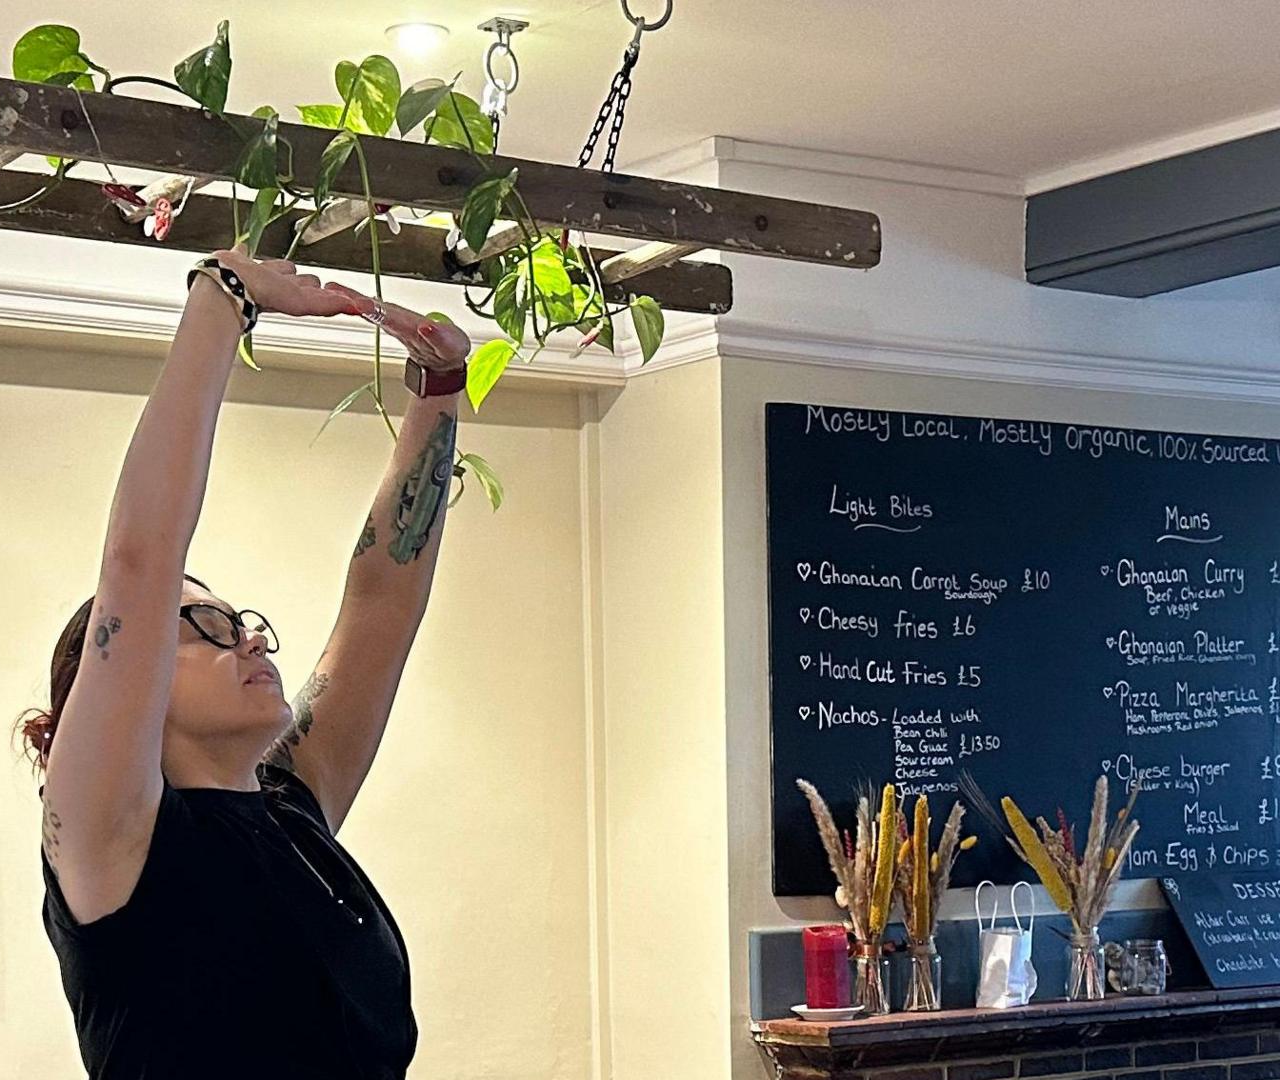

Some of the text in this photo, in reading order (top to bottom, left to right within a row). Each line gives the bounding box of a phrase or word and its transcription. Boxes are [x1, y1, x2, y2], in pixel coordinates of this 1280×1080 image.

[805, 405, 890, 441] Mostly
[979, 418, 1052, 455] Mostly
[1158, 433, 1197, 460] 100%
[1202, 438, 1269, 464] Sourced
[829, 483, 933, 522] Light Bites
[1165, 505, 1210, 531] Mains
[911, 566, 960, 592] Carrot
[969, 572, 1007, 593] Soup
[1020, 568, 1050, 593] £10
[1117, 558, 1189, 587] Ghanaian
[1204, 558, 1245, 594] Curry
[944, 590, 997, 605] Sourdough
[1180, 584, 1225, 601] Chicken
[818, 606, 879, 638] Cheesy
[952, 614, 976, 637] £6
[1149, 604, 1161, 616] or
[1193, 630, 1245, 655] Platter
[819, 651, 862, 681] Hand
[866, 660, 896, 684] Cut
[957, 665, 982, 688] £5
[1115, 680, 1160, 708] Pizza
[1176, 681, 1259, 712] Margherita
[891, 707, 942, 726] Loaded
[893, 725, 921, 739] Bean
[895, 740, 914, 753] Pea
[919, 739, 948, 753] Guac
[920, 755, 954, 766] cream
[1116, 754, 1171, 780] Cheese
[895, 767, 939, 780] Cheese
[1184, 801, 1229, 825] Meal
[1165, 841, 1198, 871] Egg
[1223, 842, 1270, 868] Chips
[1257, 913, 1274, 925] ice
